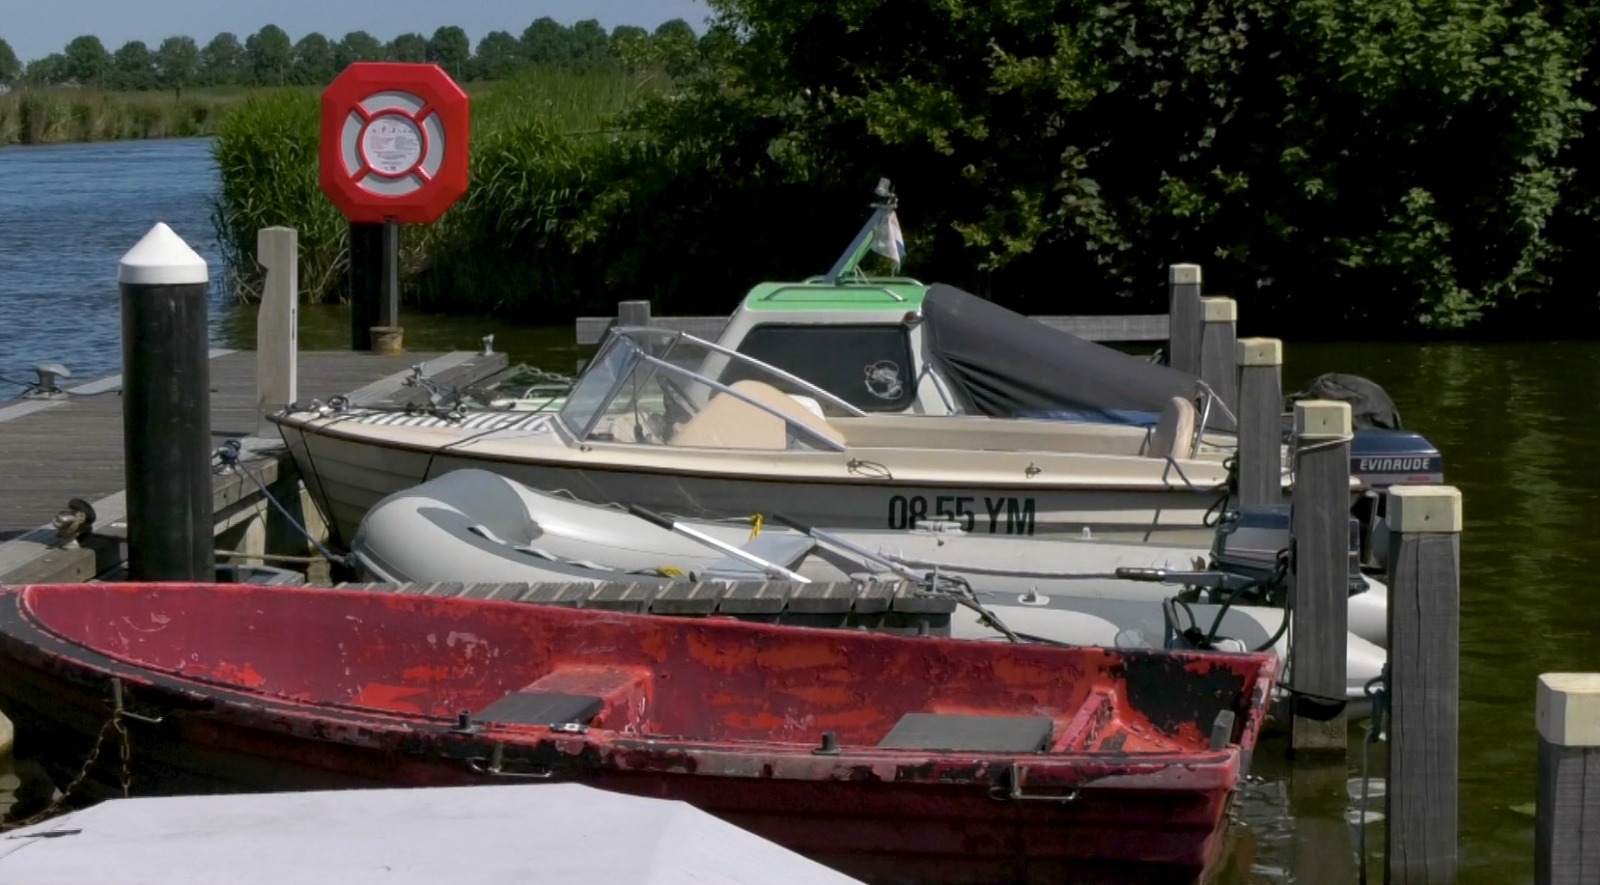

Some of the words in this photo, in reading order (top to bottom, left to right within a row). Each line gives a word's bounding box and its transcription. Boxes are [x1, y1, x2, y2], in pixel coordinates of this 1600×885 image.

[1360, 458, 1430, 471] EVINRUDE
[888, 495, 928, 530] 08
[984, 497, 1036, 536] YM
